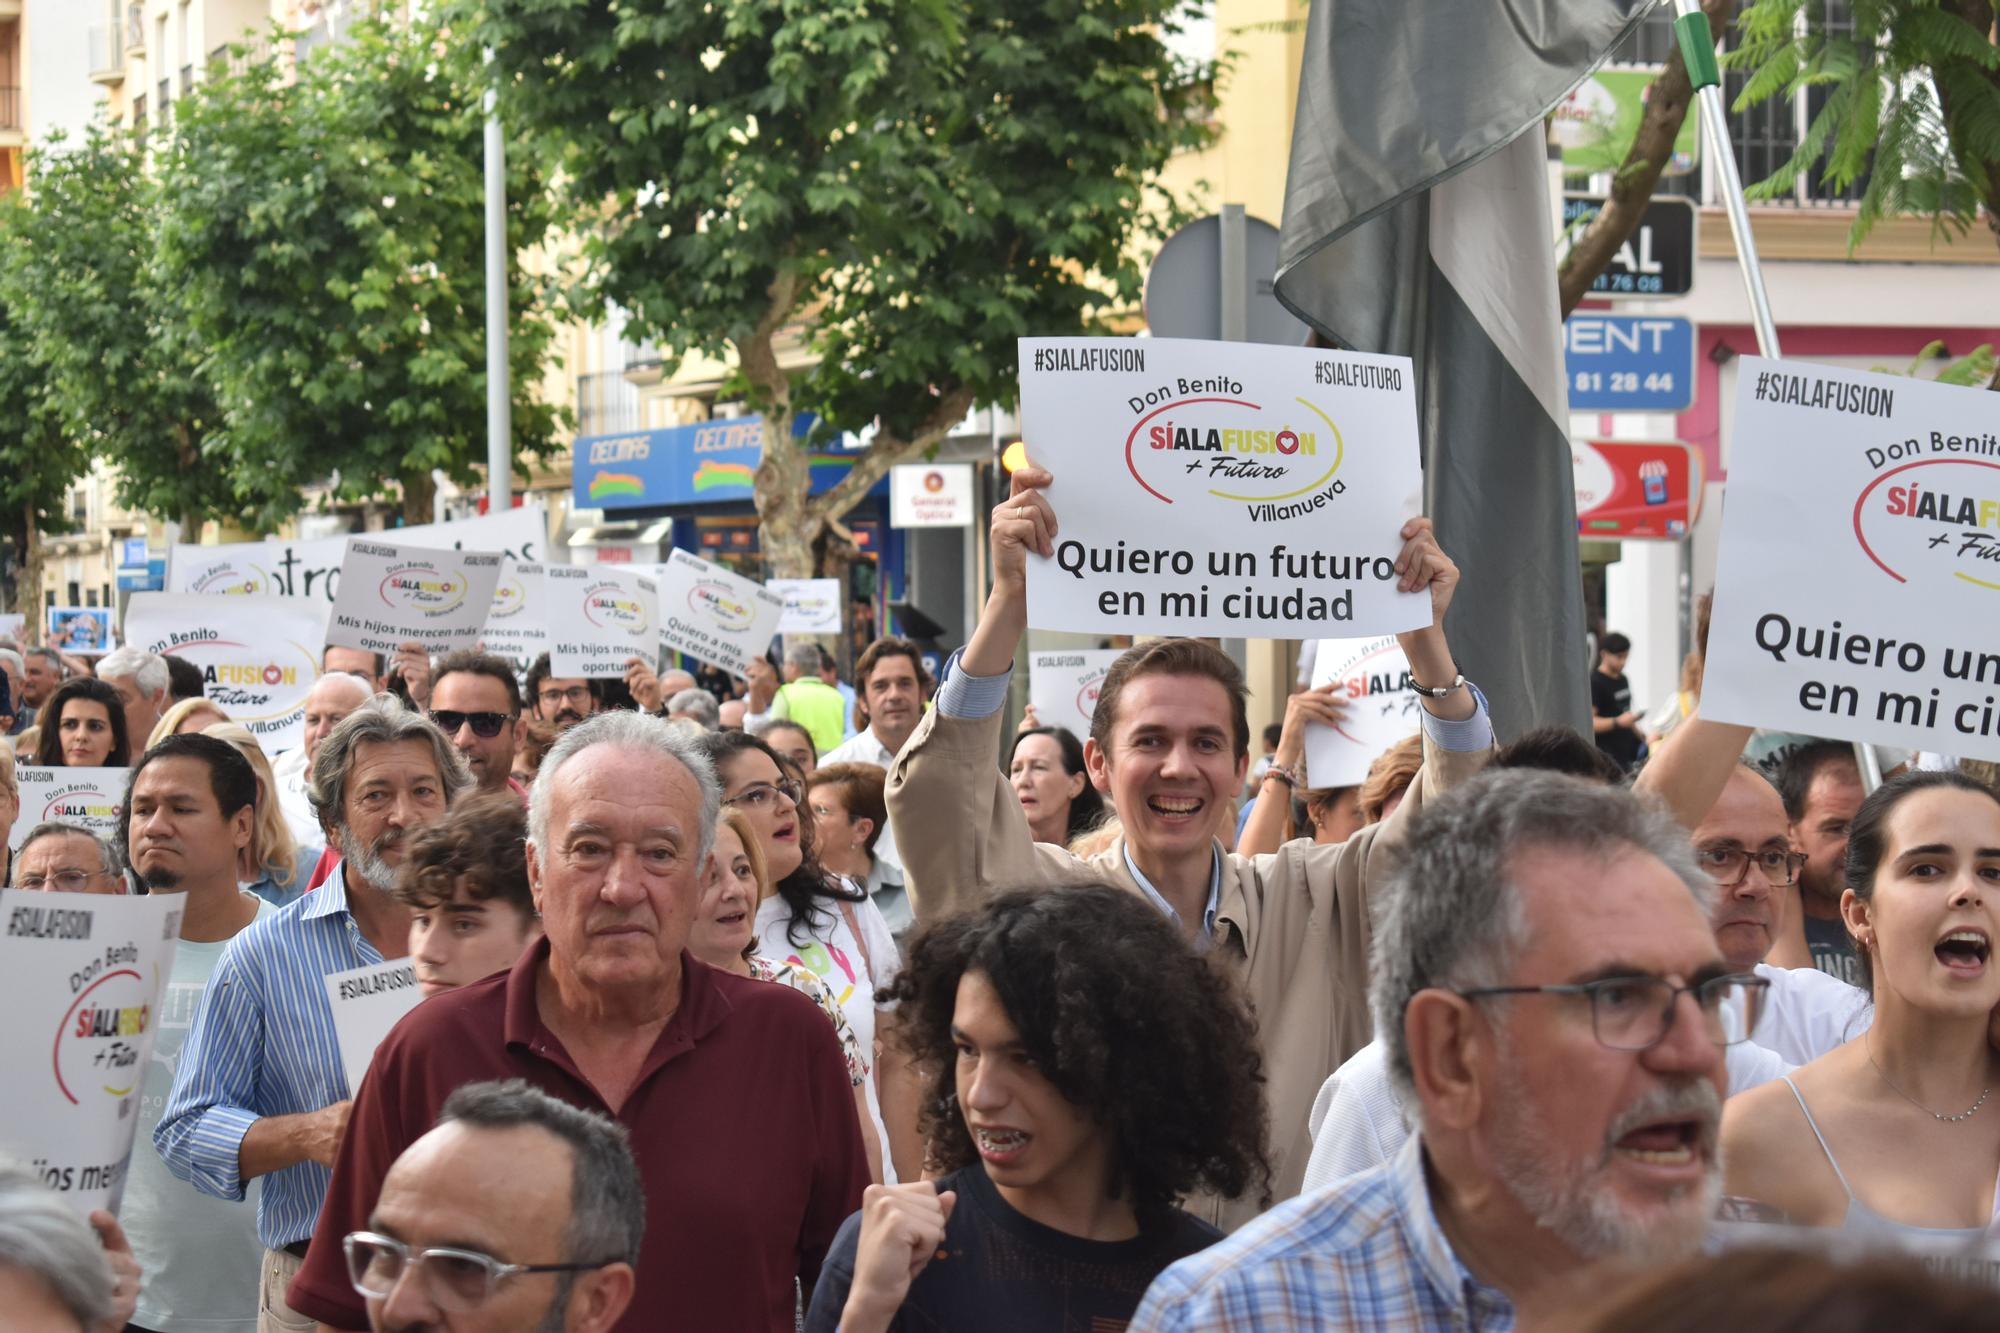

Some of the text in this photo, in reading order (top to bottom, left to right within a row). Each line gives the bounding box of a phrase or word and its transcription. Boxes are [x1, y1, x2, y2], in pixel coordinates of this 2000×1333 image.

[1563, 320, 1675, 354] ENT
[1034, 348, 1145, 373] #SIALAFUSION
[1314, 360, 1402, 392] #SIALFUTURO
[1128, 376, 1243, 414] Don Benito
[1575, 372, 1674, 392] 81 28 44
[1755, 371, 1894, 418] #SIALAFUSION
[1865, 431, 2000, 469] Don Benit
[1186, 455, 1290, 479] + Futuro
[1247, 479, 1347, 522] Villanueva
[1886, 482, 2000, 529] SÍALAF
[1928, 533, 1950, 549] +
[386, 561, 434, 573] Don Benito
[1056, 540, 1396, 581] Quiero un futuro
[1097, 585, 1354, 621] en mi ciudad
[170, 627, 219, 645] Benito
[337, 615, 477, 638] Mis hijos merecen más
[483, 627, 546, 638] erecen más
[668, 616, 743, 657] Quiero a mis
[556, 642, 578, 654] Mis
[581, 643, 610, 657] hijos
[658, 627, 683, 645] etos
[685, 640, 718, 660] cerca
[719, 654, 736, 667] de
[1037, 655, 1087, 668] #SIALAFUSION
[1755, 613, 2000, 685] Quiero un
[1078, 671, 1097, 685] Don
[208, 686, 272, 706] Futuro
[1799, 679, 2000, 737] en mi ci
[44, 782, 99, 801] Don Benito
[7, 906, 95, 940] #SIALAFUSION
[70, 957, 102, 993] Don
